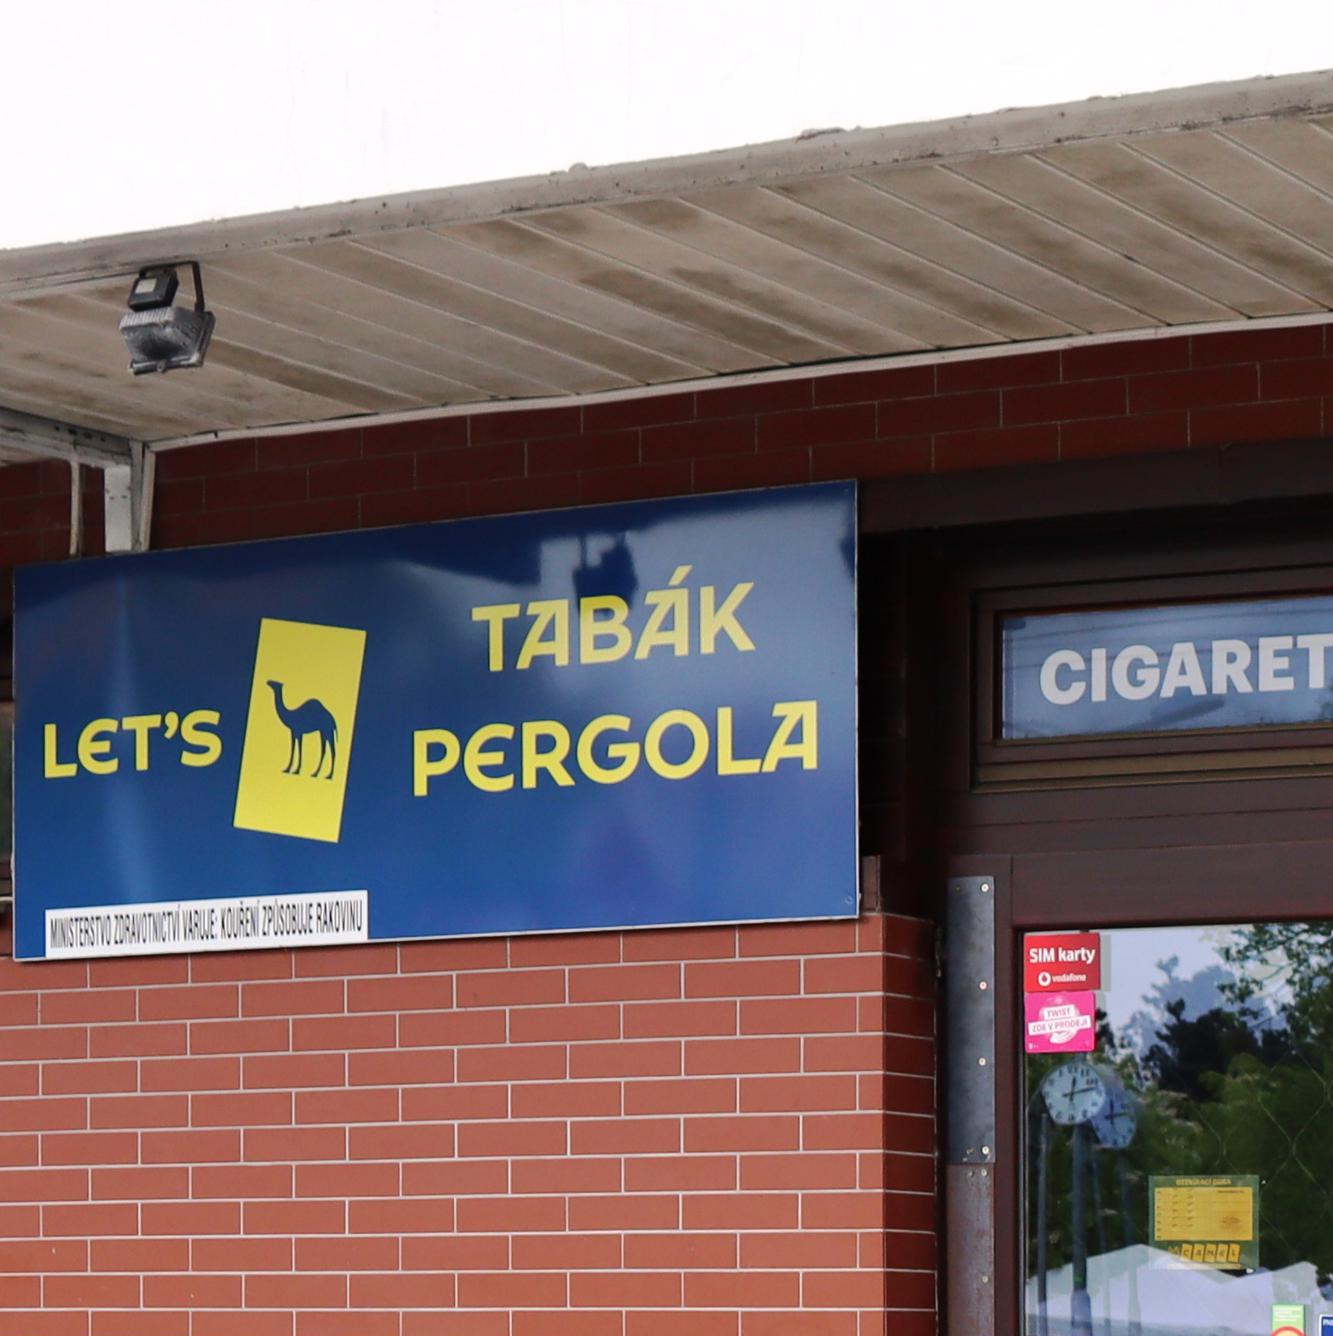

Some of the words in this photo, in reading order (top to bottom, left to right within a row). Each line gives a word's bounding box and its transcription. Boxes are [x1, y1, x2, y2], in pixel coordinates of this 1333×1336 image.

[472, 565, 756, 672] TABÁK
[44, 710, 222, 779] LET'S
[412, 699, 818, 797] PERGOLA
[50, 914, 111, 948] MINISTERSTVO
[114, 904, 180, 946] ZDRAVOTNICTVÍ
[220, 899, 261, 938] KOUŘENÍ
[316, 899, 363, 933] RAKOVINU
[1029, 947, 1056, 964] SIM
[1058, 946, 1096, 965] karty
[1051, 972, 1087, 983] vodafone
